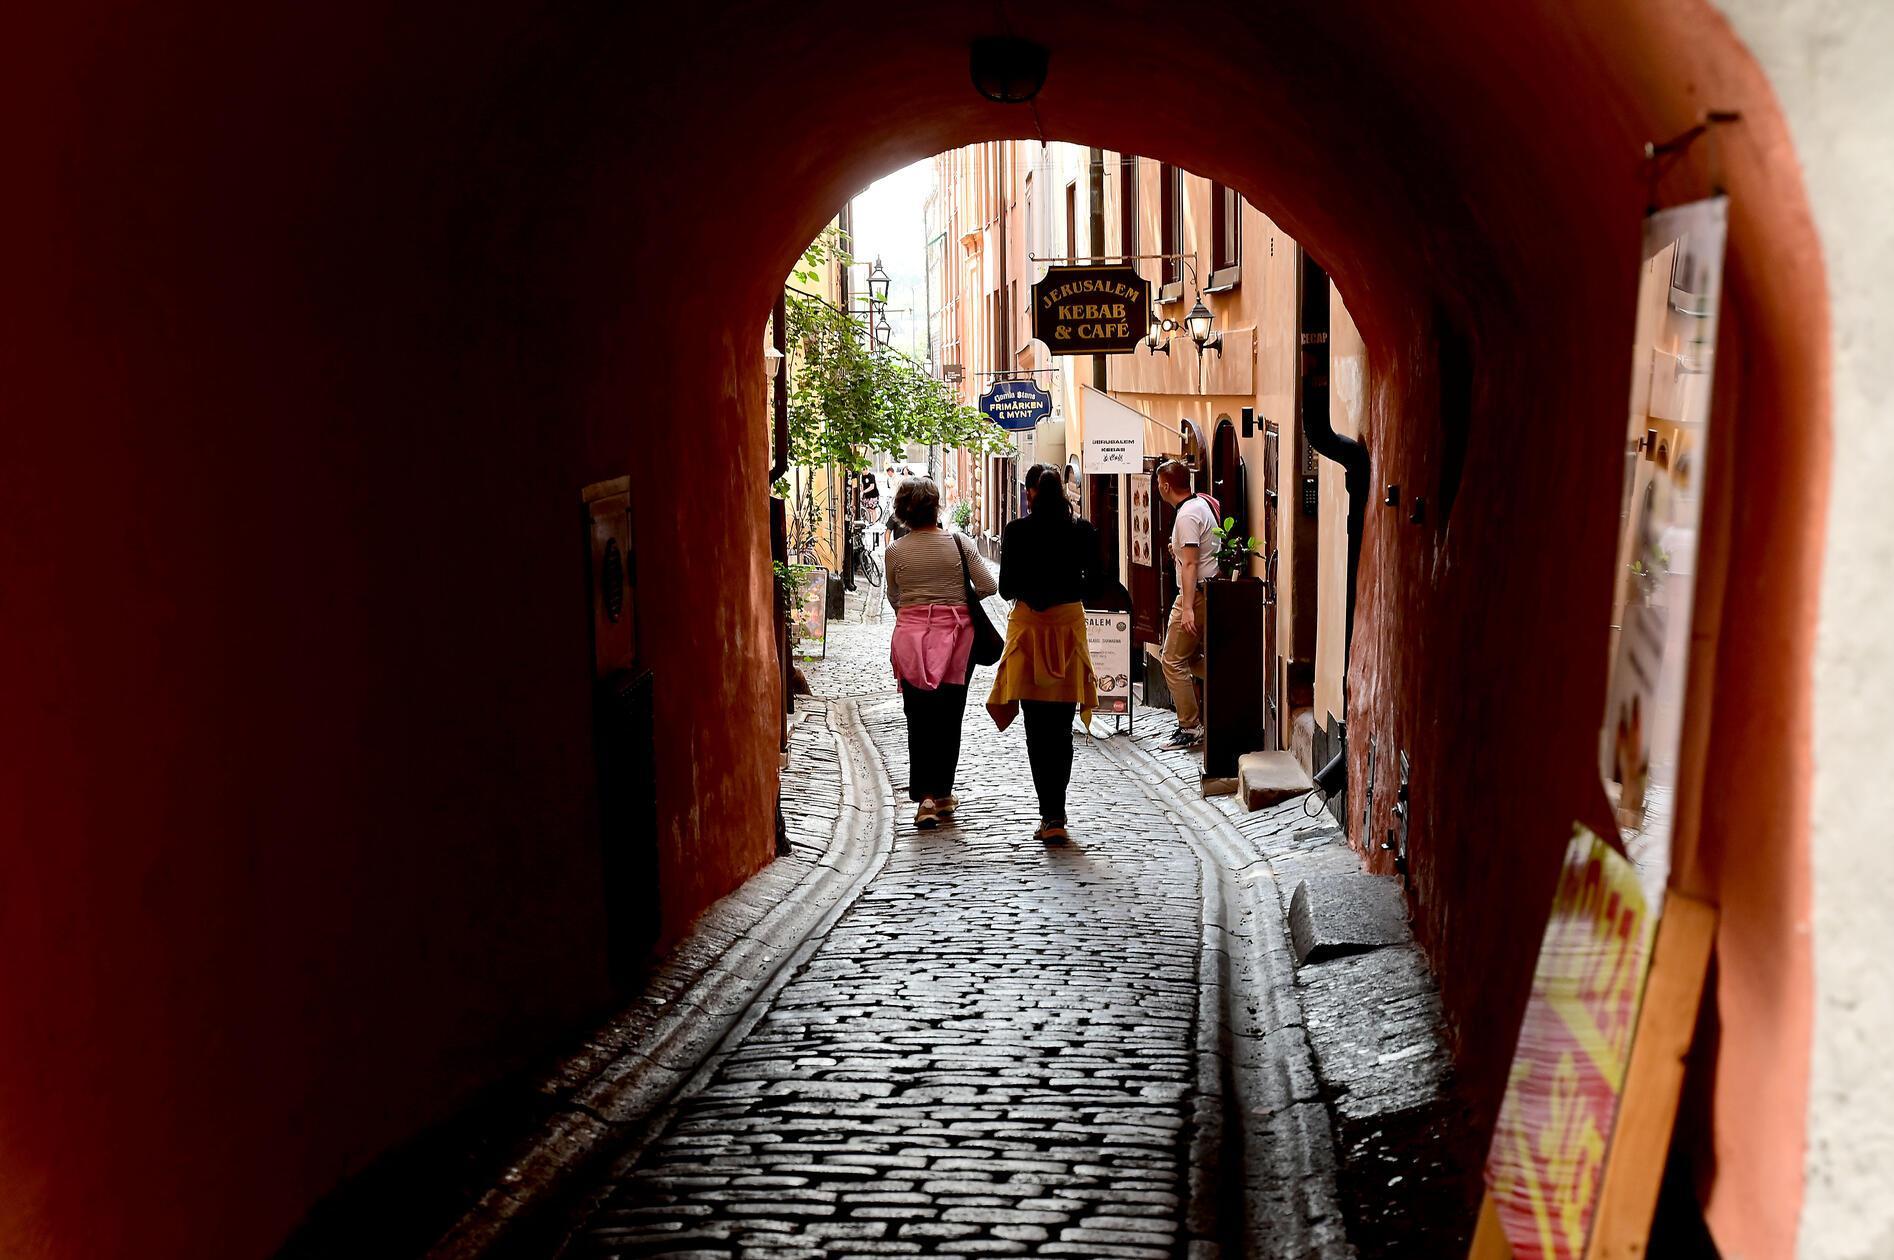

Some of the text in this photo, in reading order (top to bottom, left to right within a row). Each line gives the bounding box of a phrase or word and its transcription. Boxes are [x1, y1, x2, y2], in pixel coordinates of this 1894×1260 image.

[1043, 280, 1139, 309] JERUSALEM
[1058, 303, 1126, 320] KEBAB
[1055, 318, 1130, 339] & CAFÉ
[1006, 410, 1033, 419] MYNT
